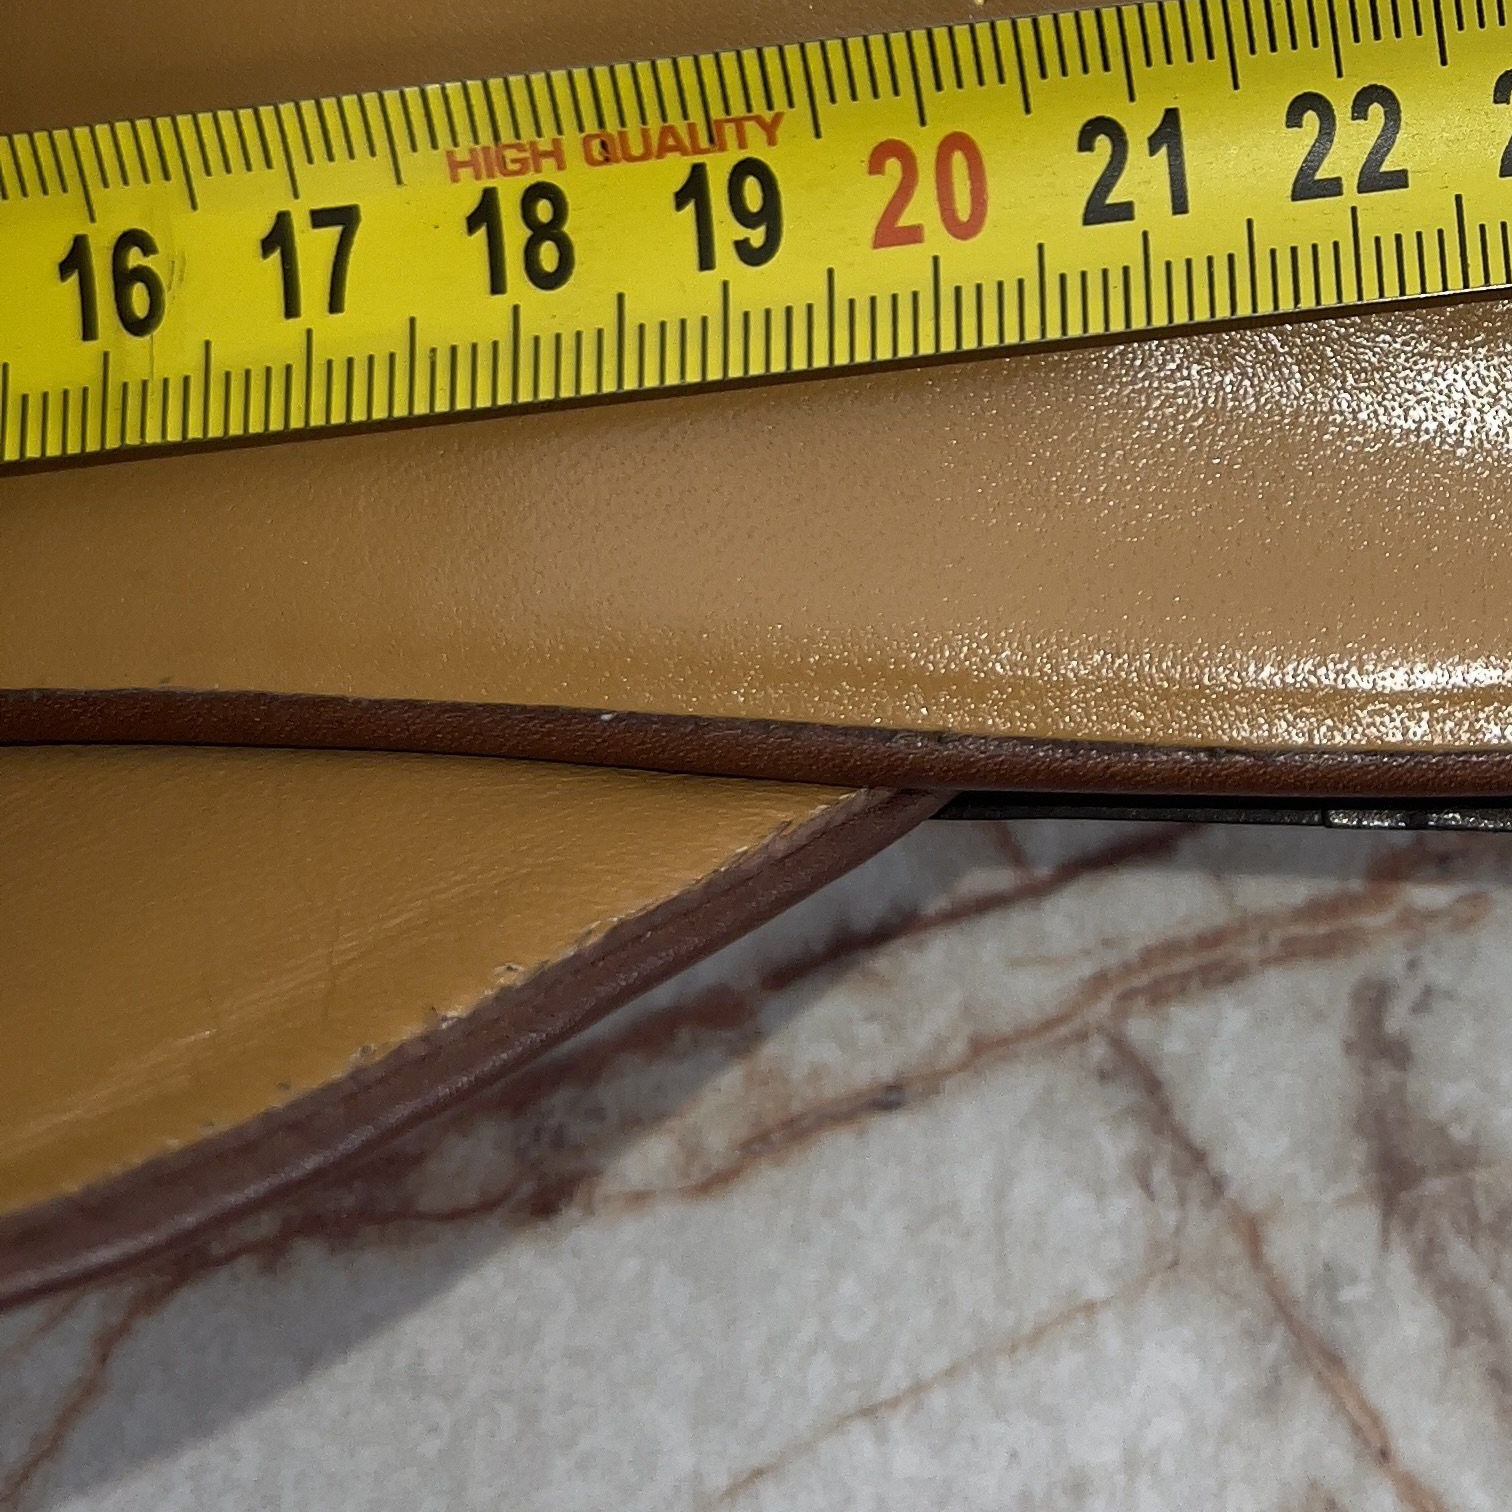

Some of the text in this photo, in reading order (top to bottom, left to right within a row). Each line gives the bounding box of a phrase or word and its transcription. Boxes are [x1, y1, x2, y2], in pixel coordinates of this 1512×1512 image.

[58, 228, 166, 341] 16
[260, 203, 362, 320] 17
[465, 180, 576, 296] 18
[673, 157, 784, 271] 19
[867, 129, 989, 250] 20
[1077, 107, 1189, 226] 21
[1284, 82, 1409, 202] 22
[445, 110, 788, 183] HIGH QUALITY
